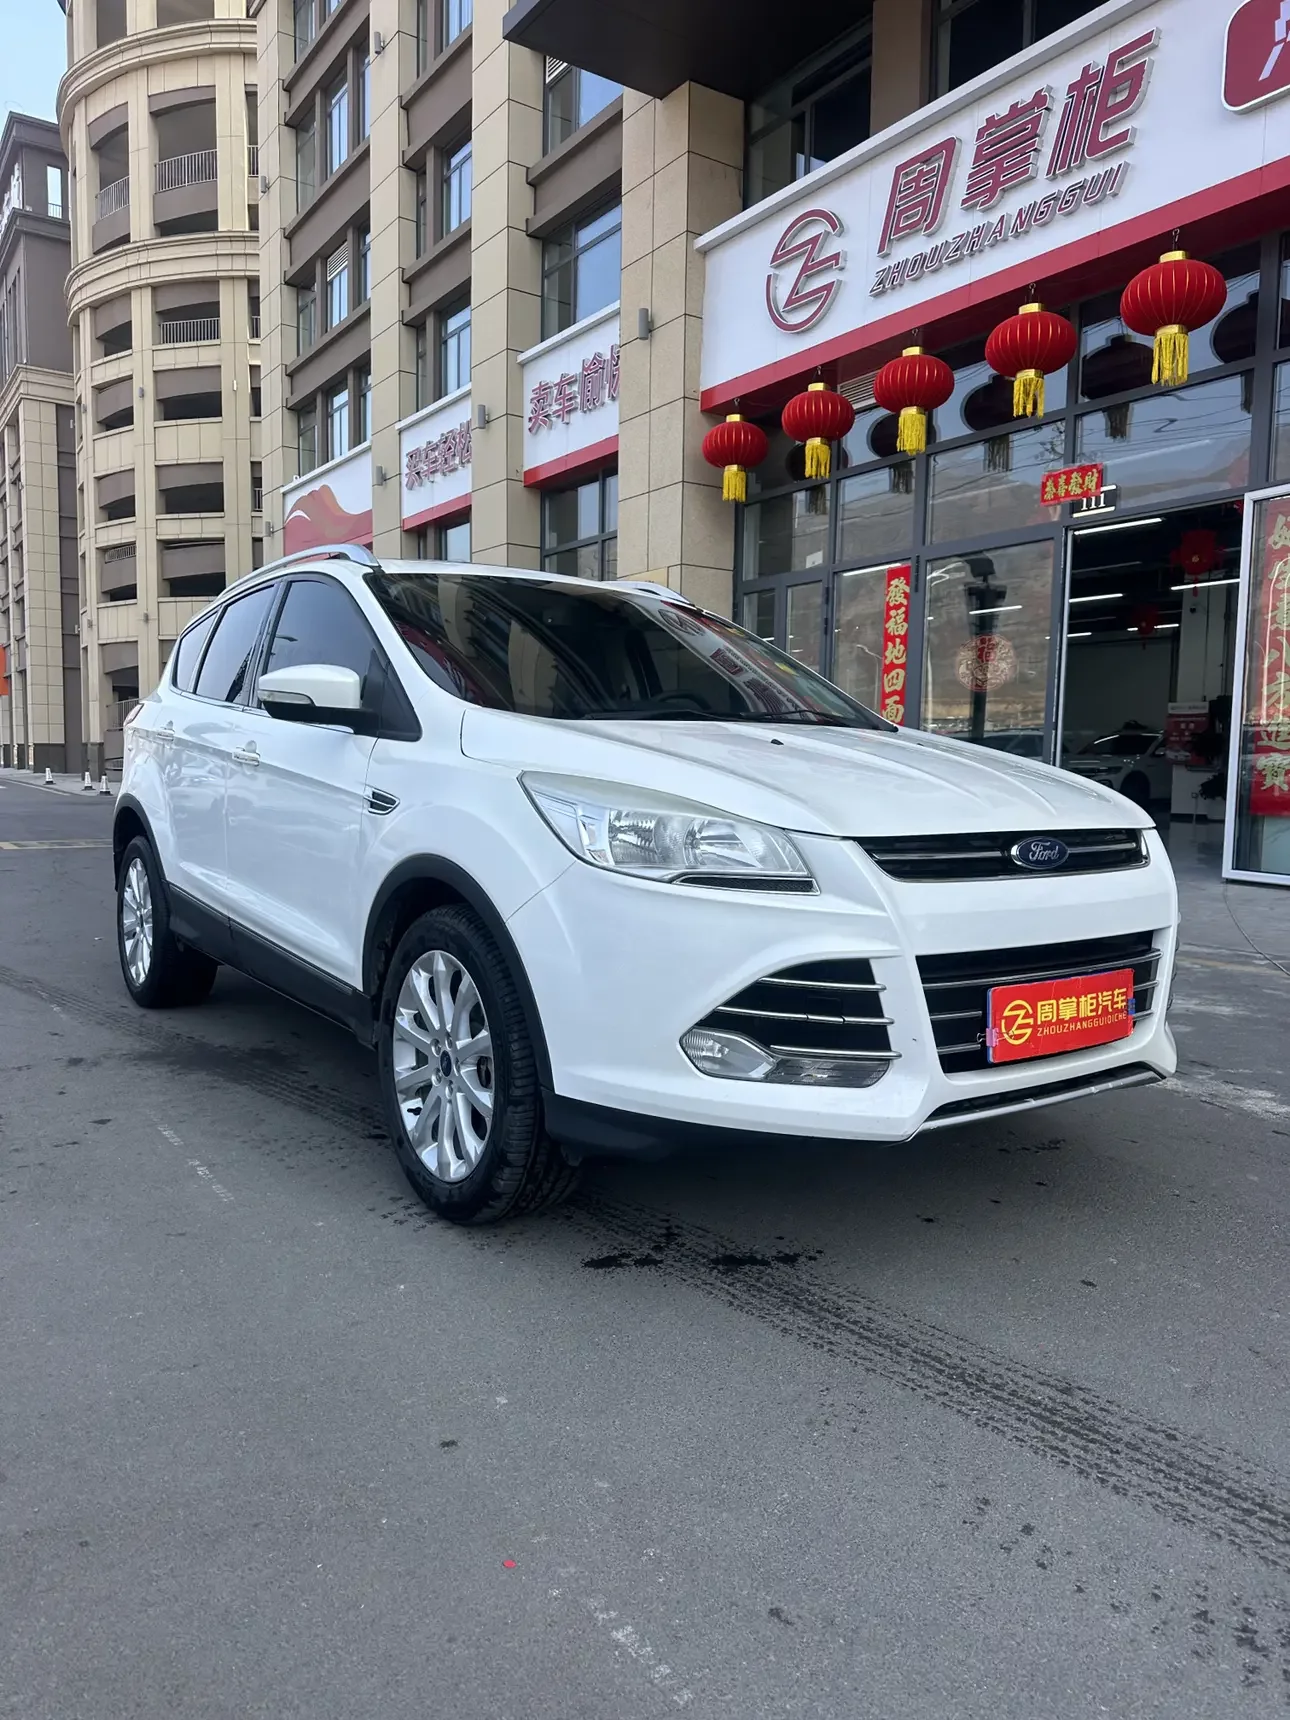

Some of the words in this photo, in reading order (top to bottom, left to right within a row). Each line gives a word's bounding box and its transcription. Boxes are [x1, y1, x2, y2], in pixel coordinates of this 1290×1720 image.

[878, 27, 1161, 258] 周掌柜
[868, 161, 1131, 298] ZHOUZHANGGUI
[1029, 841, 1060, 861] Ford
[1037, 988, 1127, 1025] 周掌柜汽车
